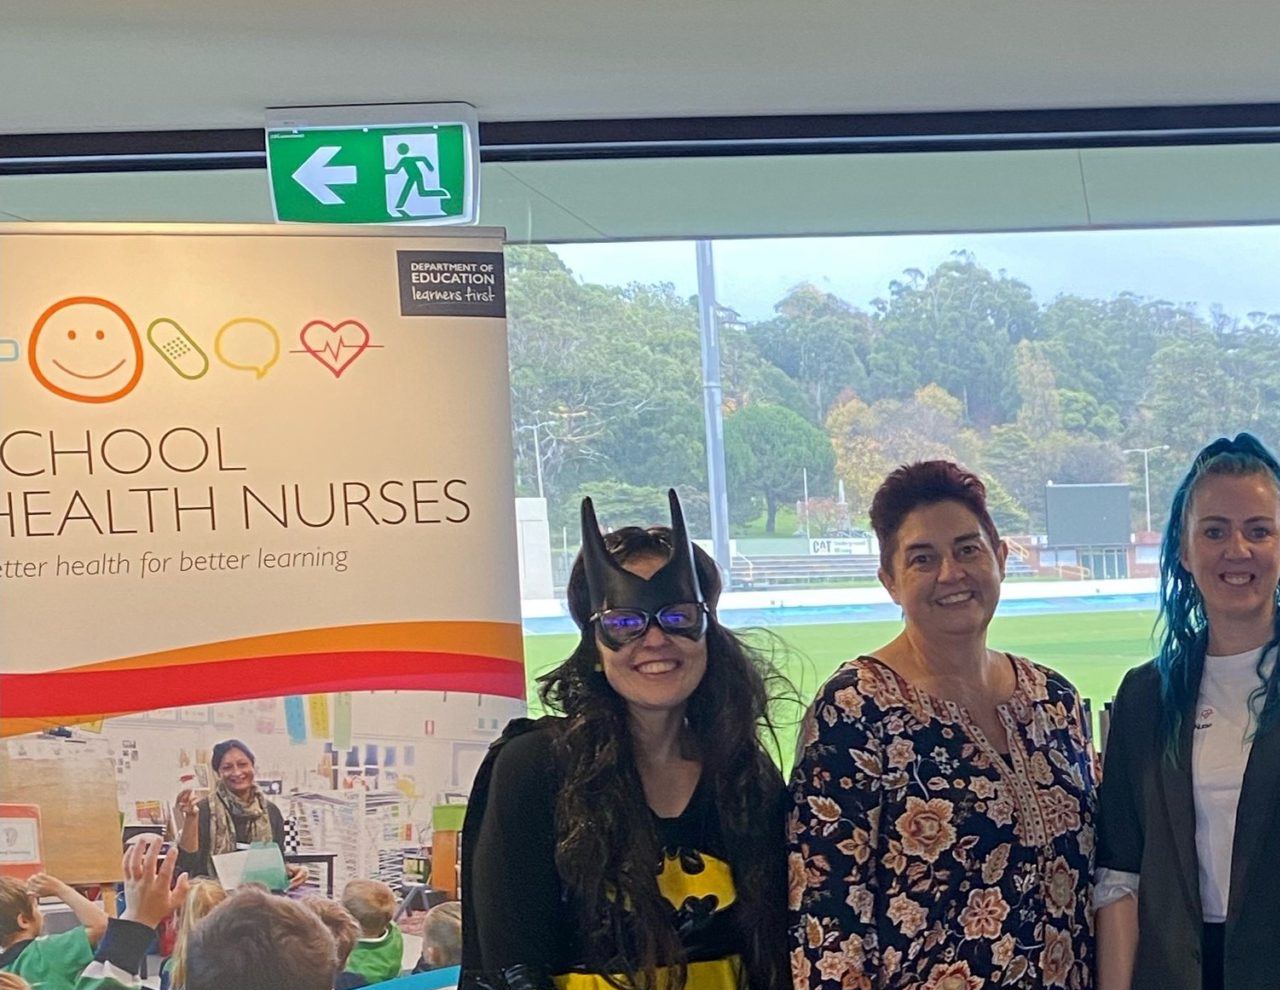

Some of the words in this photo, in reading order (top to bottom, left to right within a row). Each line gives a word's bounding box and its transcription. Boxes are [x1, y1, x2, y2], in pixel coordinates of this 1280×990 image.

[410, 262, 477, 272] DEPARTMENT
[480, 264, 494, 272] OF
[411, 272, 495, 284] EDUCATION
[412, 286, 462, 301] learners
[465, 286, 495, 301] first
[0, 427, 247, 477] CHOOL
[242, 479, 471, 531] NURSES
[813, 541, 831, 553] CAT
[0, 559, 48, 579] tter
[56, 552, 130, 577] health
[140, 550, 172, 579] for
[180, 548, 250, 573] better
[257, 546, 349, 573] learning
